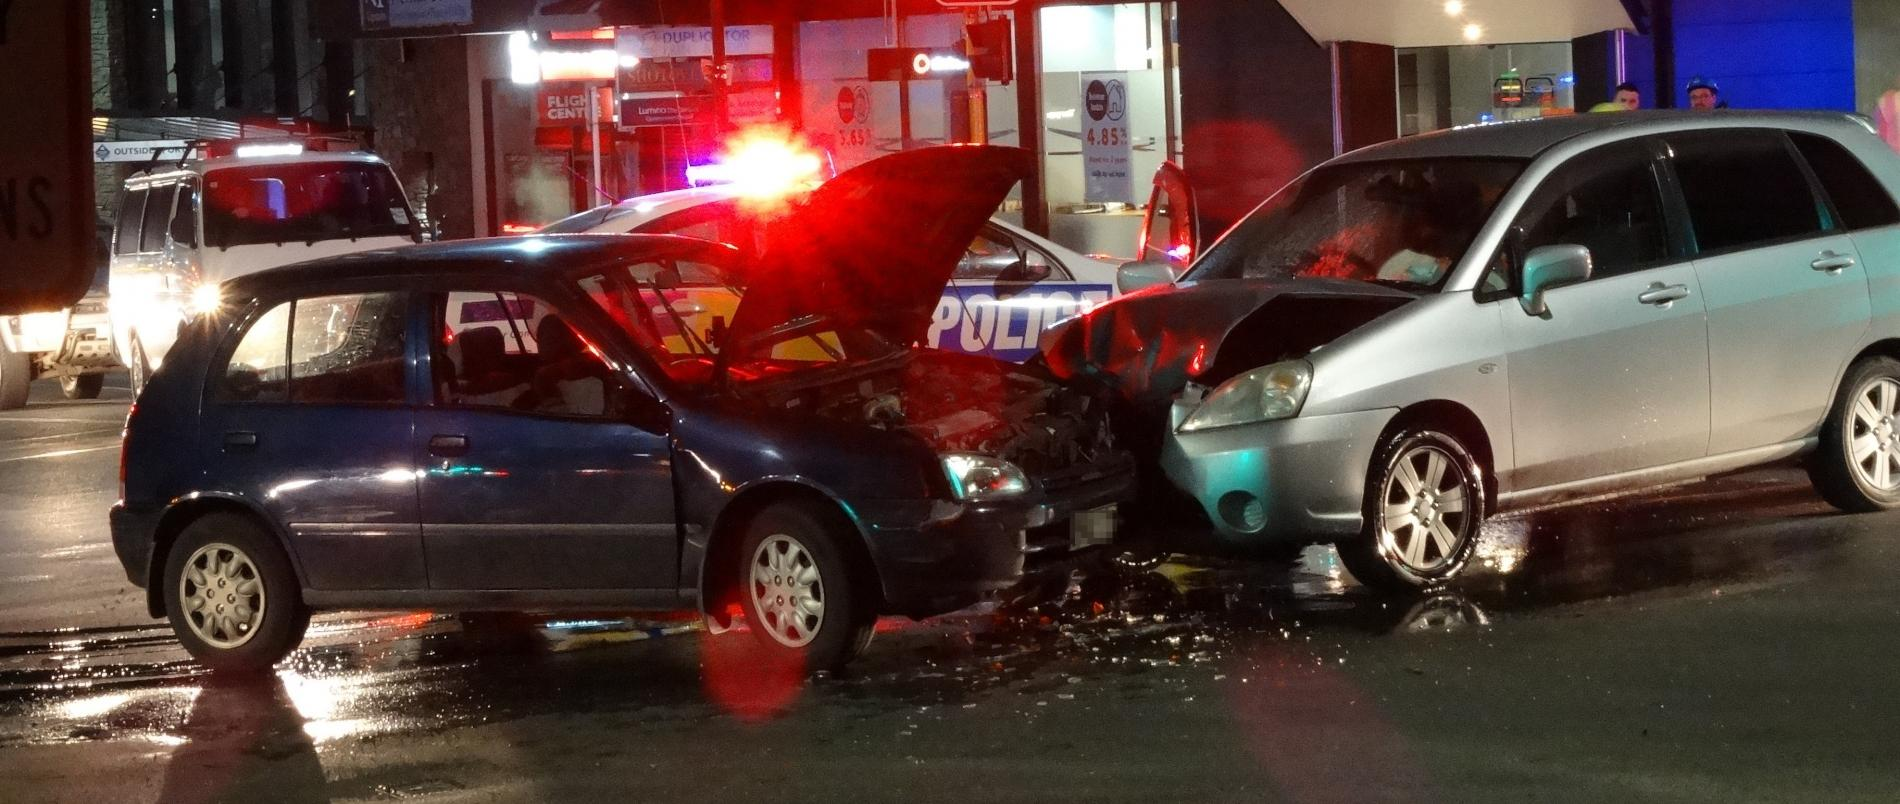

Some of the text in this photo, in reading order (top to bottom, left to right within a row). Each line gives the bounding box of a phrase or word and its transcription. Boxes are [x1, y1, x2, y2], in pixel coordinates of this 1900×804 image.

[663, 28, 751, 44] DUPLICTOR
[547, 95, 601, 108] FLIGH
[547, 107, 602, 120] CENT
